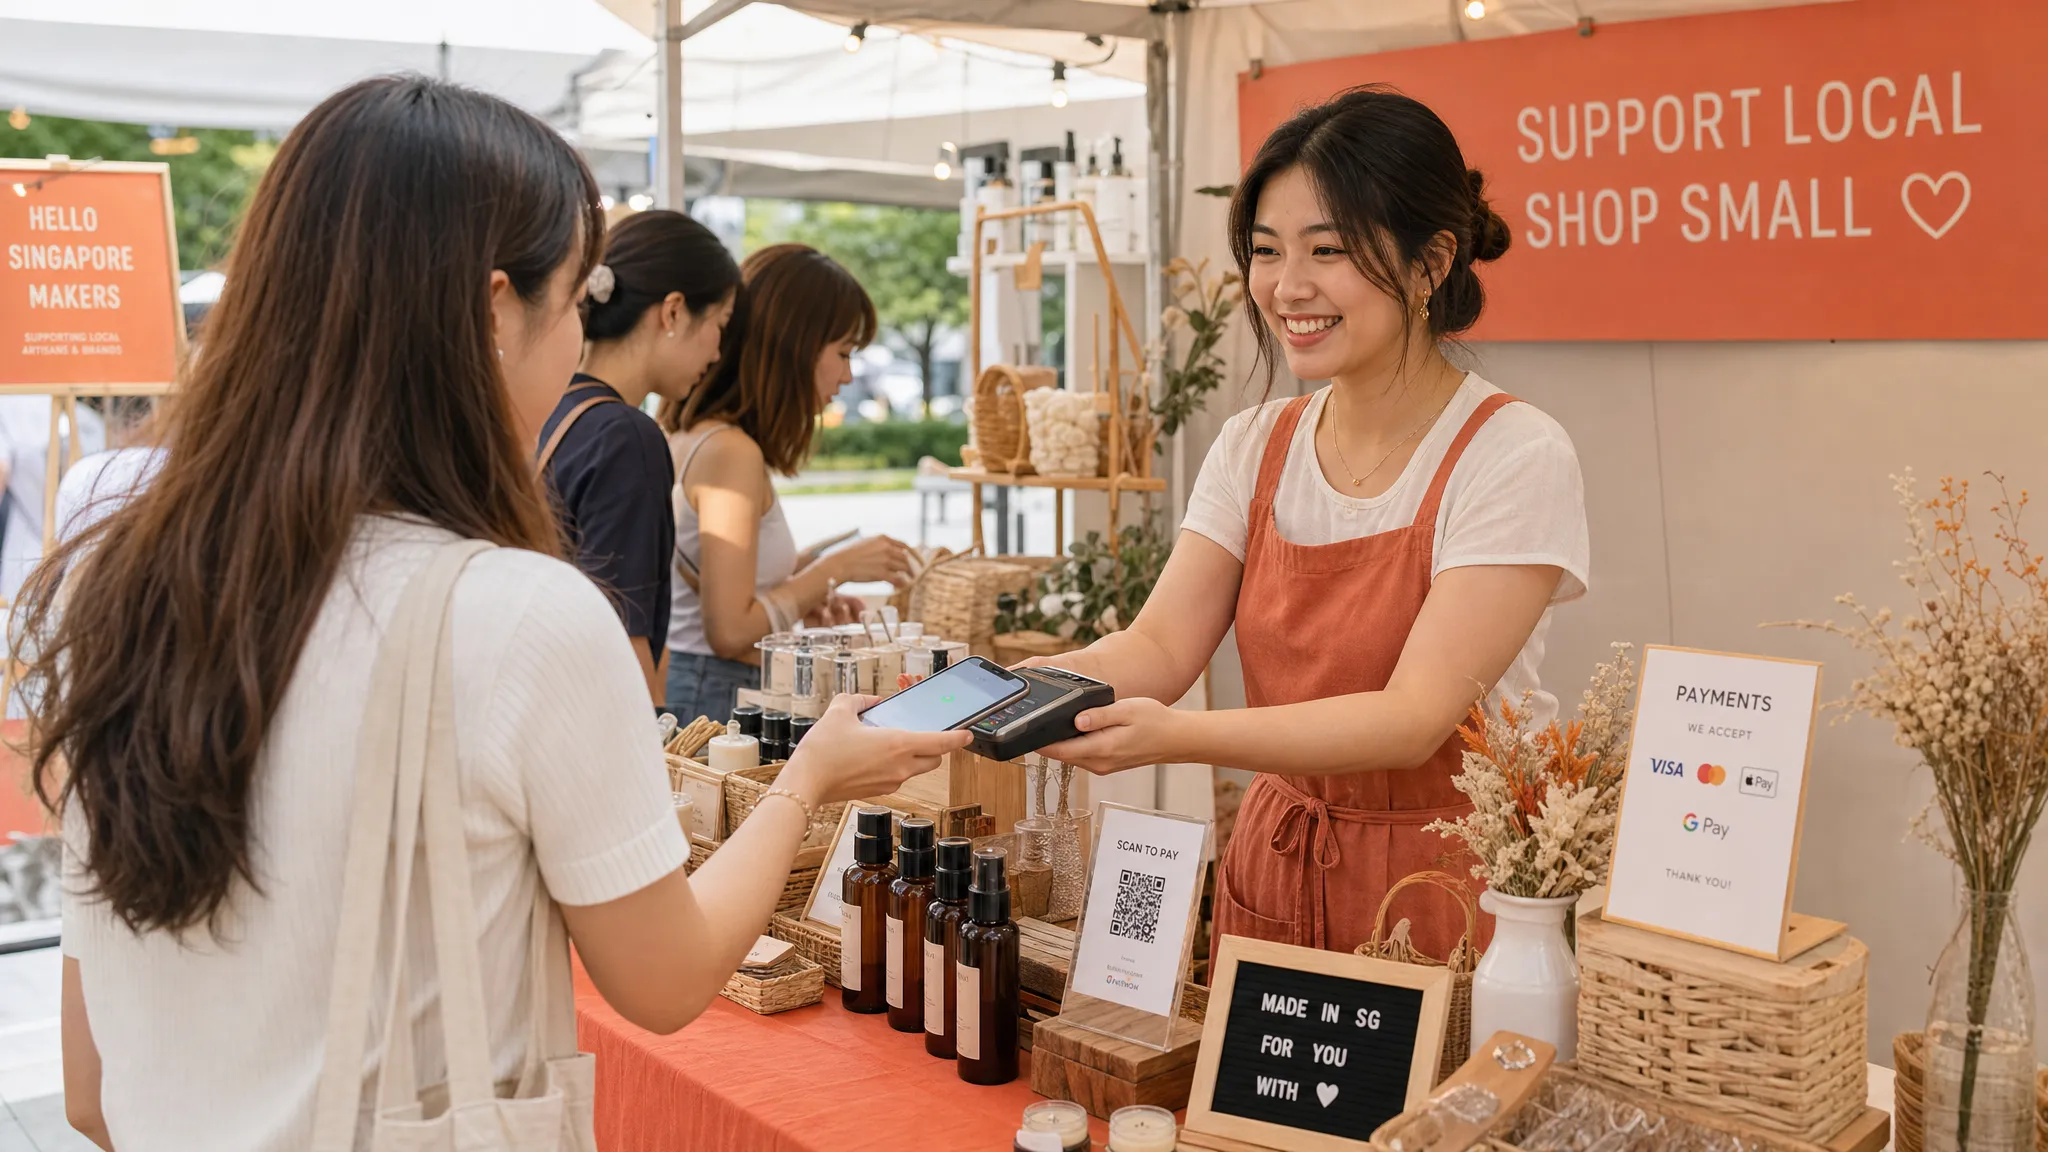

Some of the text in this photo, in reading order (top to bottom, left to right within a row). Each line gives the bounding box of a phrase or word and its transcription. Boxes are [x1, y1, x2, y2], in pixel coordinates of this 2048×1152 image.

[1517, 71, 1982, 164] SUPPORT LOCAL
[29, 205, 98, 232] HELLO
[1525, 176, 1872, 249] SHOP SMALL
[8, 244, 134, 271] SINGAPORE
[29, 284, 121, 310] MAKERS
[22, 345, 68, 355] ARTISANS
[82, 345, 122, 355] BRANDS
[24, 332, 120, 342] SUPPORTING LOCAL
[1676, 685, 1772, 712] PAYMENTS
[1688, 723, 1753, 740] WE ACCEPT
[1650, 757, 1773, 791] VISA Pay
[1703, 817, 1730, 840] Pay
[1117, 839, 1179, 860] SCAN TO PAY
[1665, 868, 1732, 890] THANK YOU!
[1261, 993, 1381, 1030] MADE IN SG
[1260, 1034, 1348, 1067] FOR YOU
[1256, 1075, 1299, 1101] WITH
